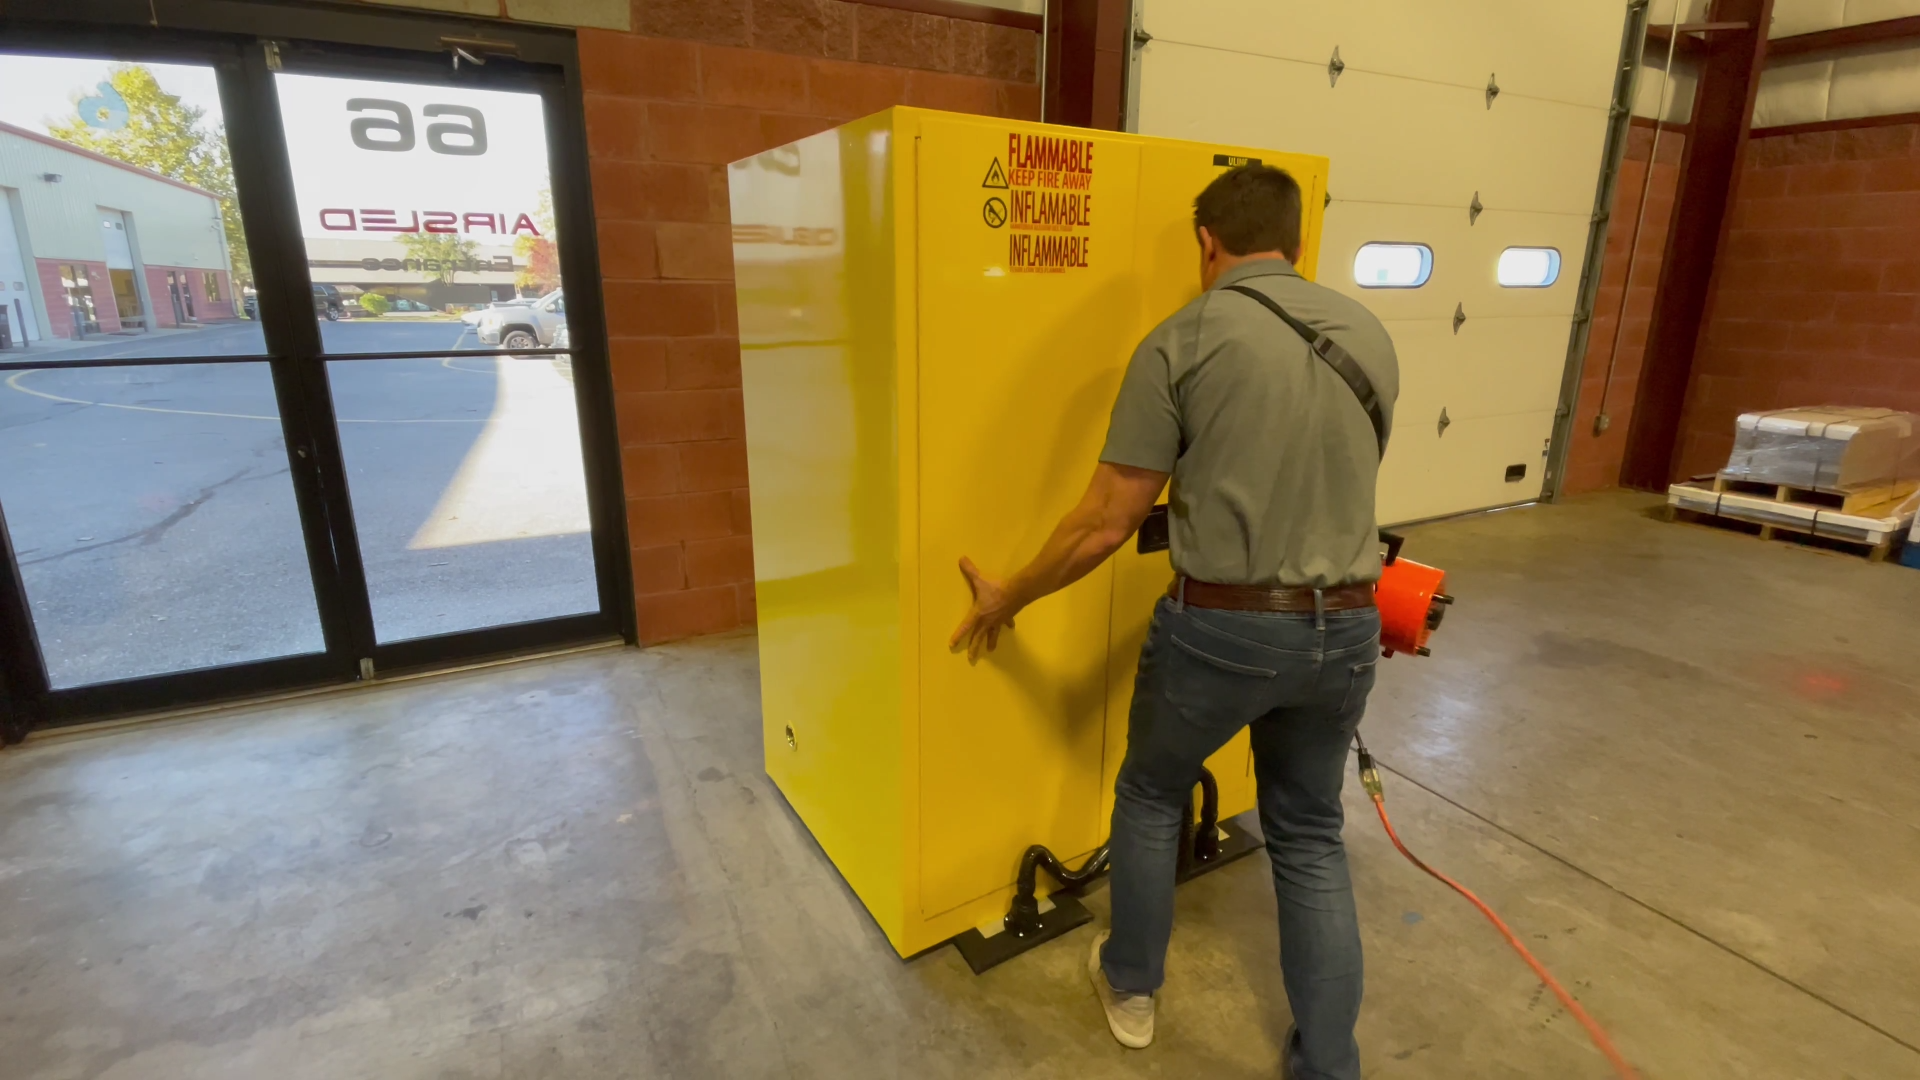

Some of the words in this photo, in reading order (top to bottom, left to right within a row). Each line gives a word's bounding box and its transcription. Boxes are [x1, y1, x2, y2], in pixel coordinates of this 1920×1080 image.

[1008, 132, 1094, 174] FLAMMABLE
[1008, 168, 1035, 187] KEEP
[1037, 171, 1060, 189] FIRE
[1062, 172, 1092, 191] AWAY
[1010, 189, 1092, 227] INFLAMABLE
[1009, 233, 1090, 268] INFLAMMABLE
